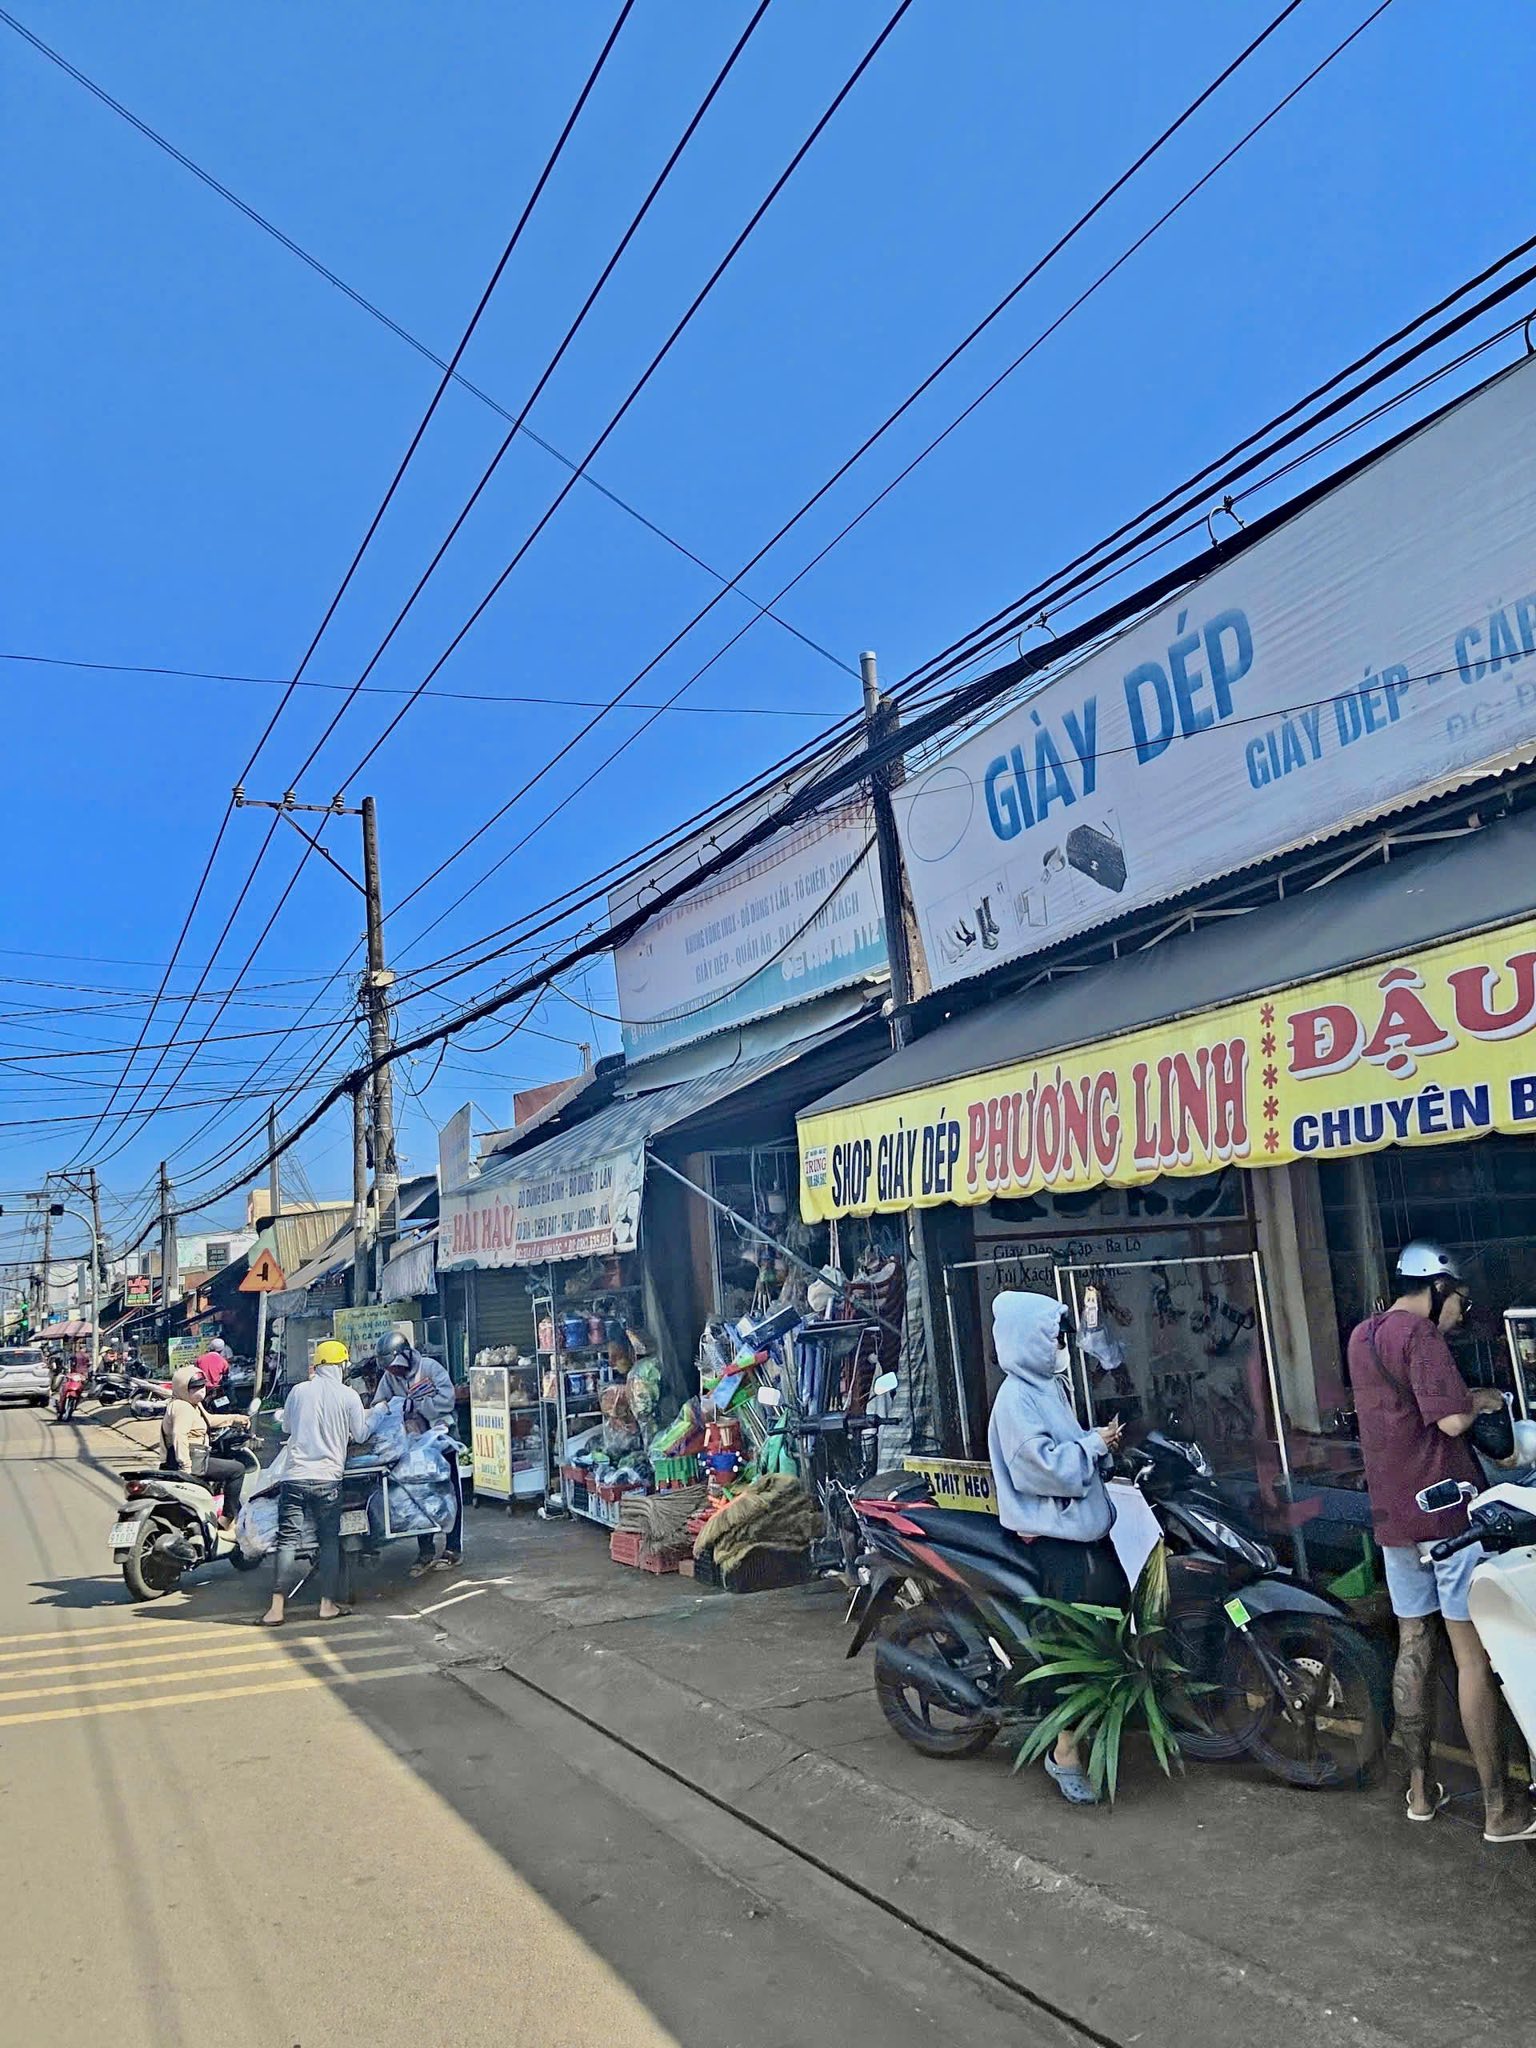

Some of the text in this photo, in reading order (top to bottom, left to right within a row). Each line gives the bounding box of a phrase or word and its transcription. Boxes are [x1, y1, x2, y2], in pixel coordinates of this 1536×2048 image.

[984, 608, 1254, 841] GIÀY DÉP
[1245, 705, 1322, 789] GIÀY
[1333, 665, 1409, 747] DÉP
[832, 1039, 1250, 1208] SHOP GIÀY DÉP PHƯƠNG LINH
[1292, 1082, 1490, 1152] CHUYÊN
[1106, 1238, 1121, 1253] Ba
[934, 1472, 960, 1500] THỊT
[964, 1475, 990, 1499] HEO
